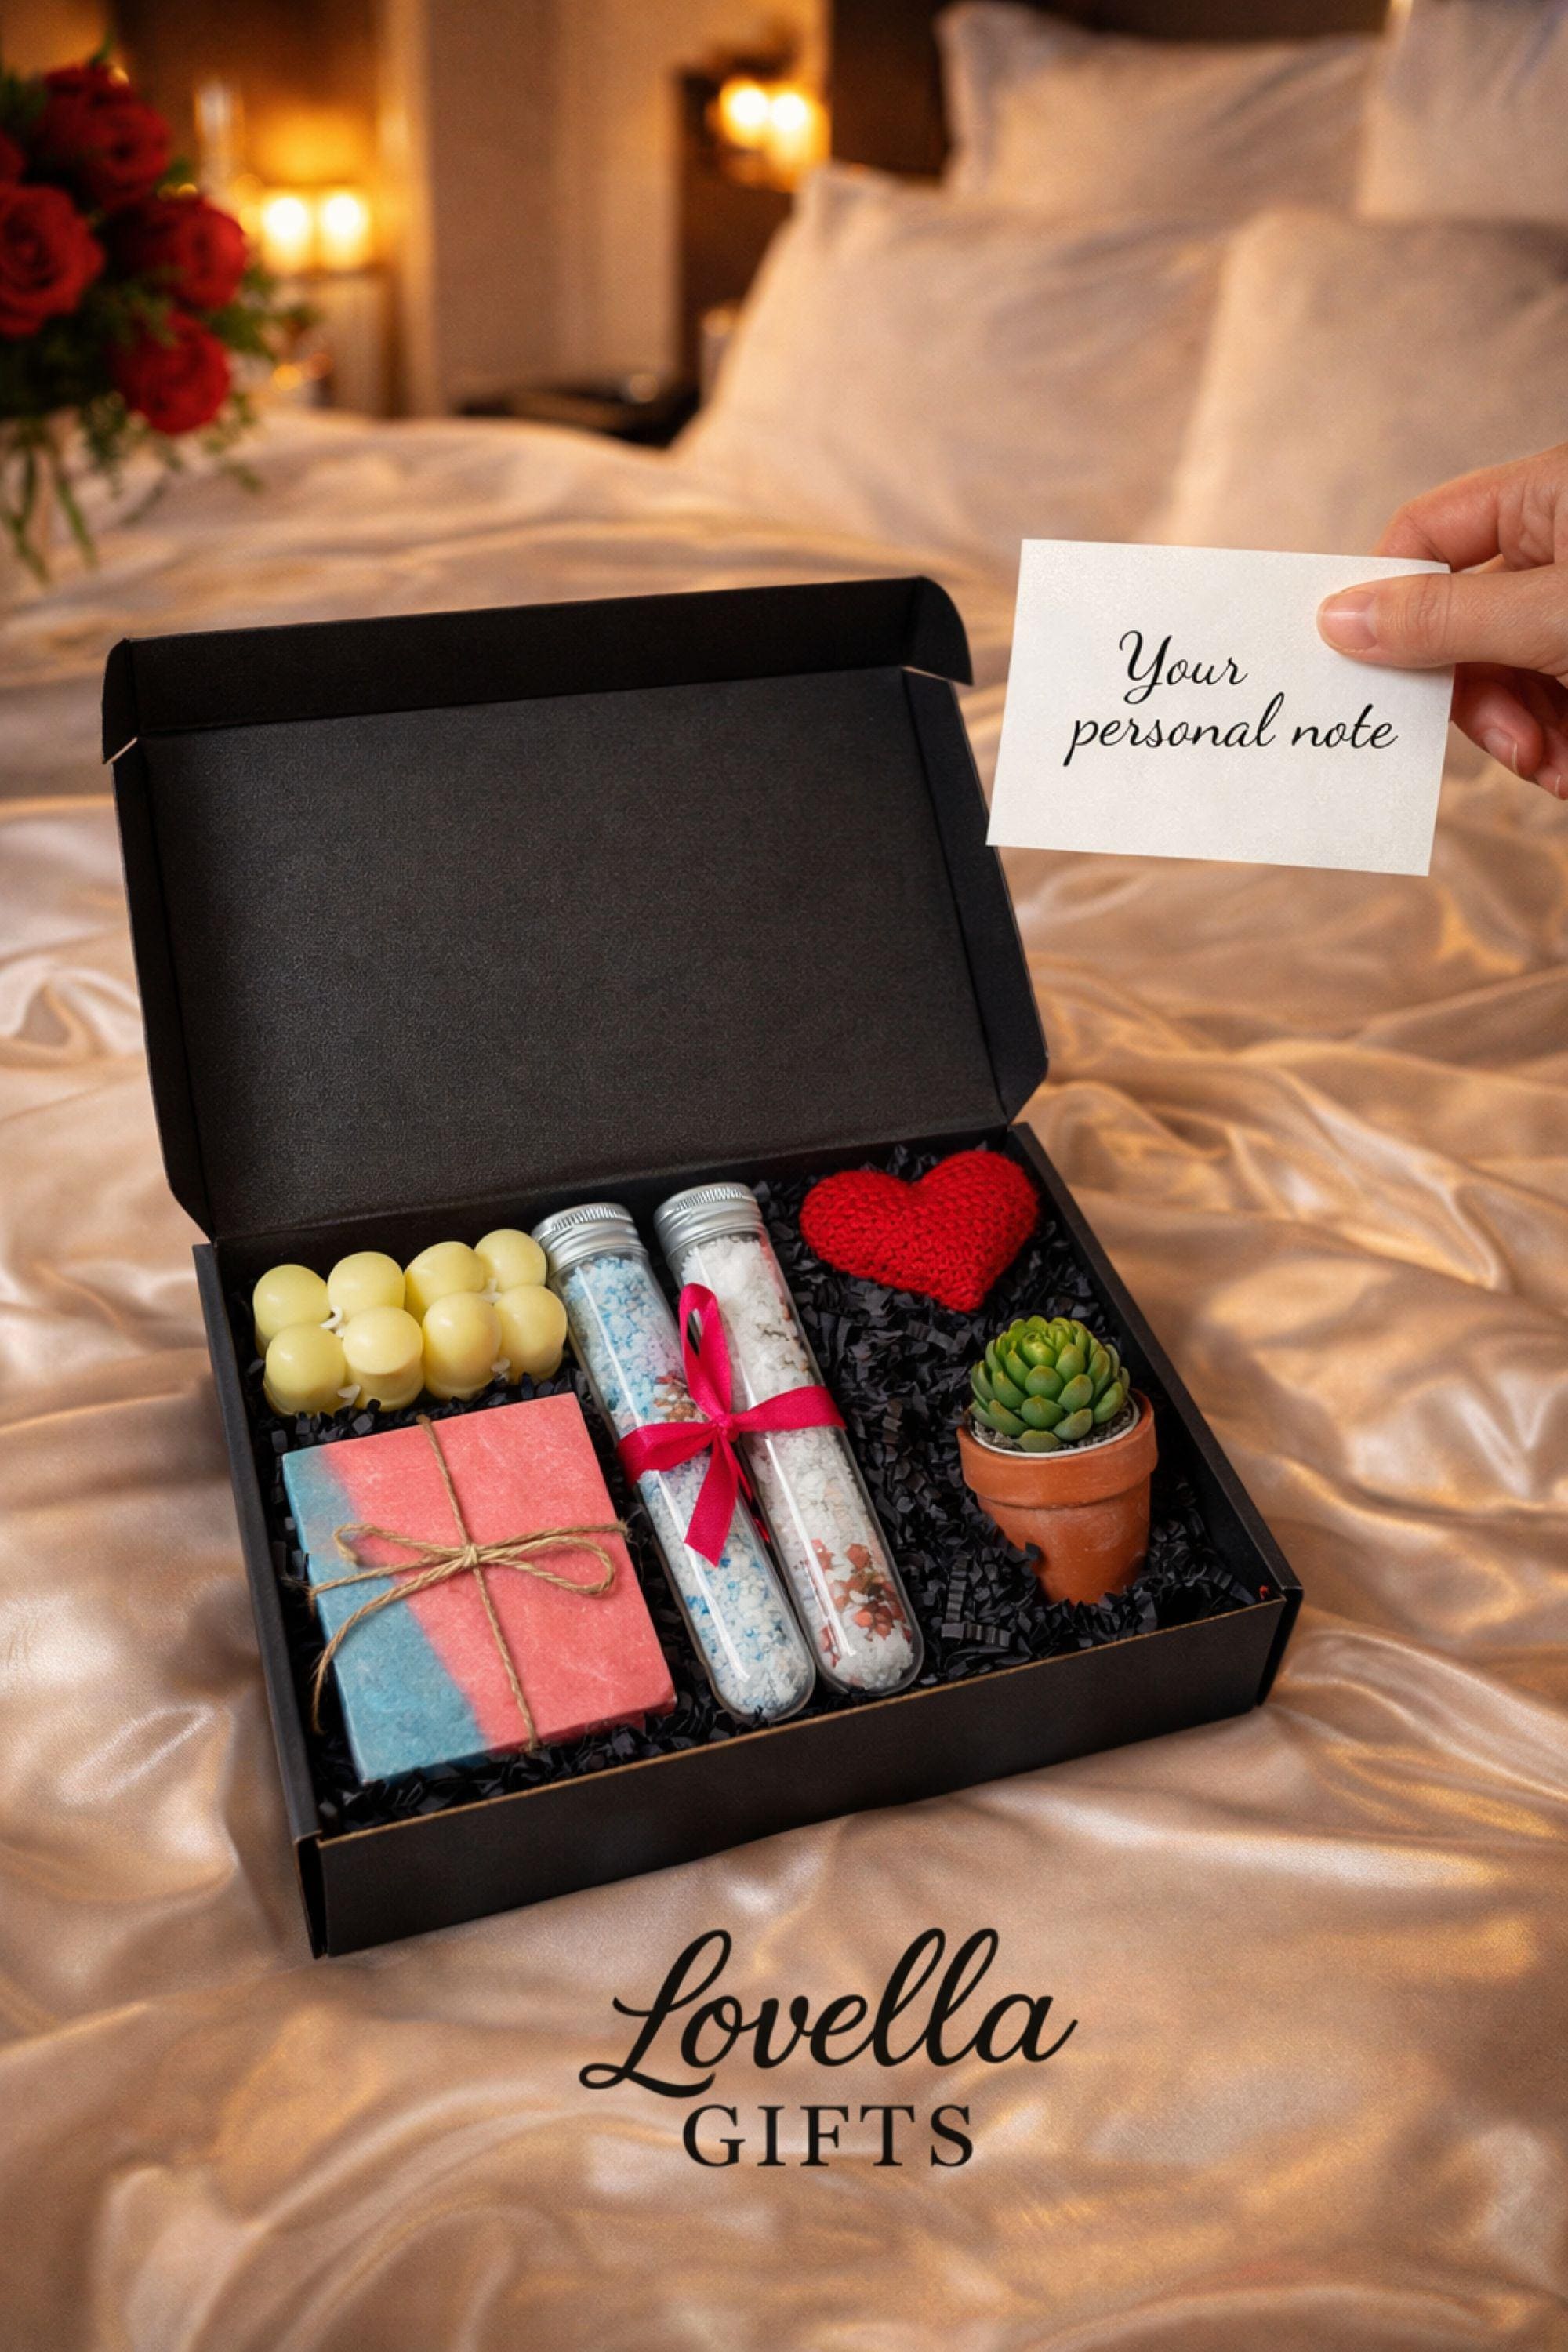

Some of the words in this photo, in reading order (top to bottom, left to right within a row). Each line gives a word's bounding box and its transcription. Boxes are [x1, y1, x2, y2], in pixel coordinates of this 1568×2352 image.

[1119, 630, 1248, 705] Your
[1063, 691, 1286, 767] personal
[1291, 703, 1399, 750] note
